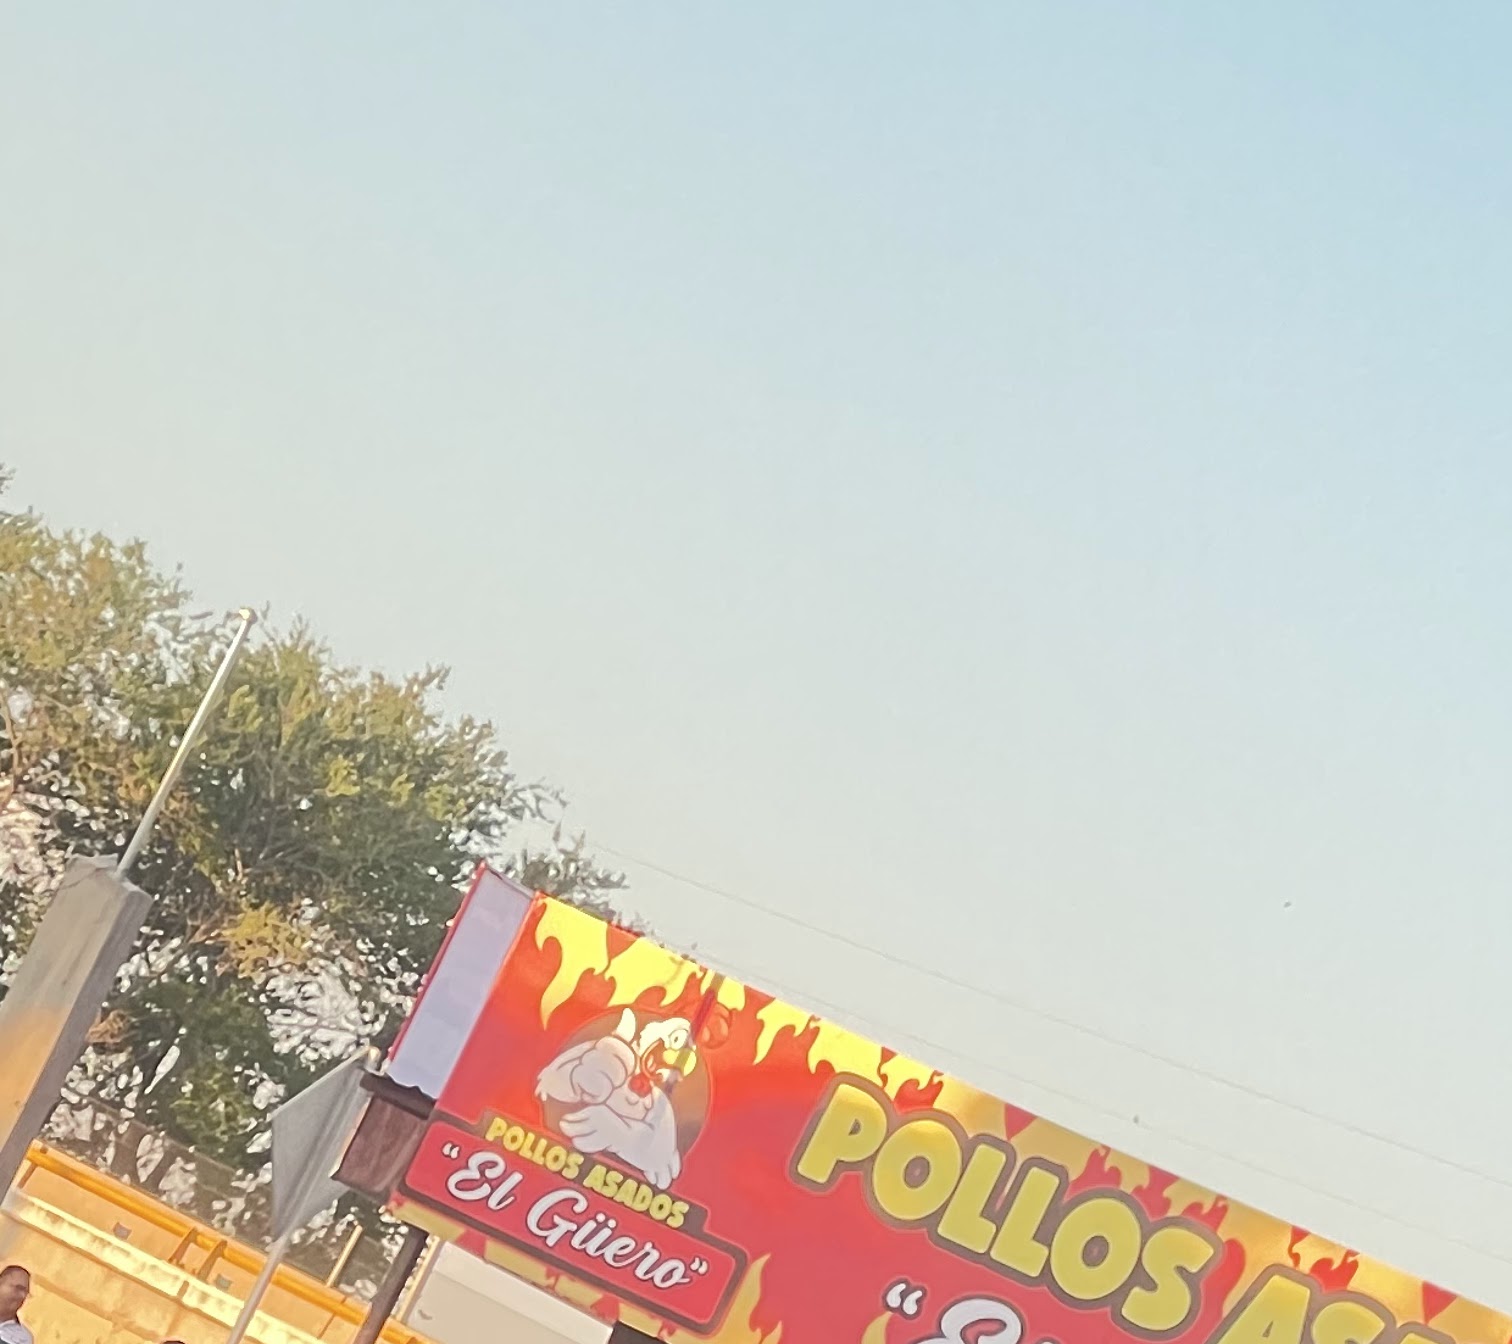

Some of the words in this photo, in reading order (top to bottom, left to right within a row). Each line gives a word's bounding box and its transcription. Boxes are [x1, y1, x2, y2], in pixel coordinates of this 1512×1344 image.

[485, 1117, 584, 1179] POLLOS
[582, 1164, 690, 1228] ASADOS
[797, 1083, 1215, 1331] POLLOS
